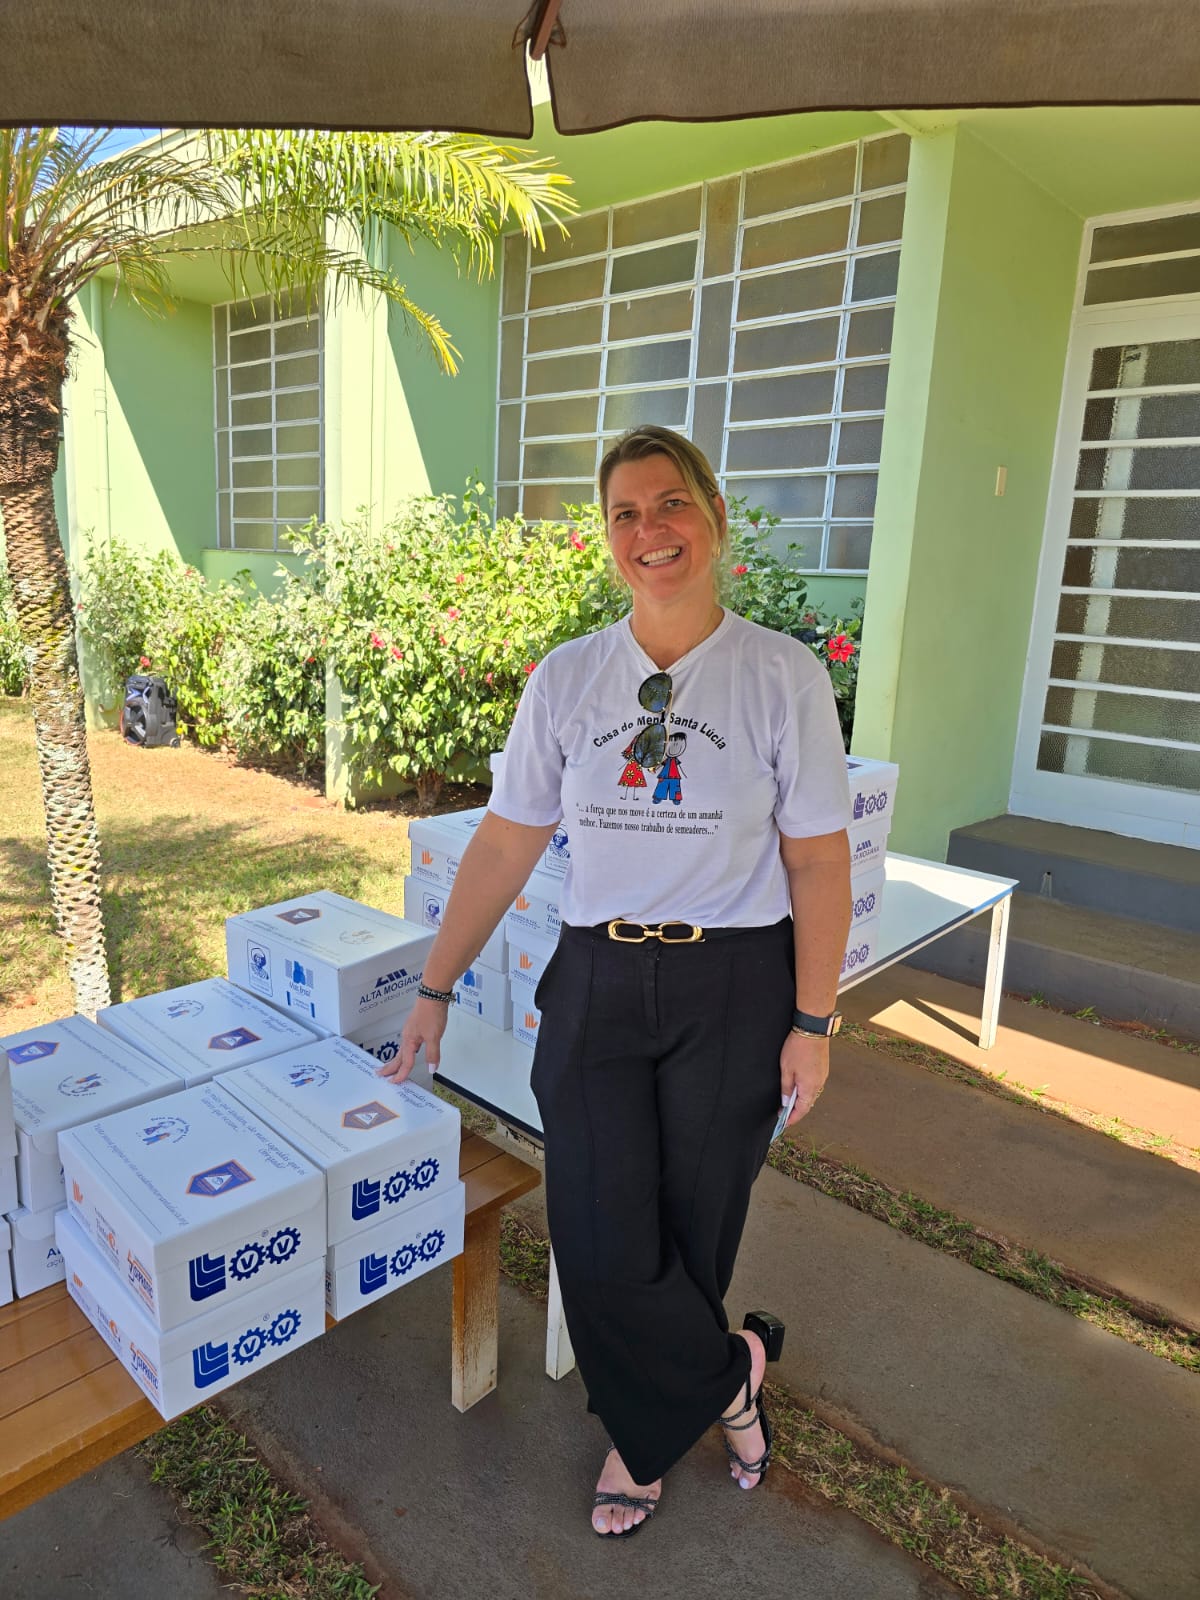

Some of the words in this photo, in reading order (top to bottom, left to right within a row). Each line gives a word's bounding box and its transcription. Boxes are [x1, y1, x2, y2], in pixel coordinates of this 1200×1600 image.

[593, 728, 619, 748] Casa
[621, 722, 634, 732] do
[670, 712, 699, 730] Santa
[700, 723, 727, 750] Lúcia
[590, 803, 605, 817] força
[606, 807, 617, 817] que
[618, 808, 628, 816] nos
[629, 809, 645, 817] move
[656, 810, 677, 819] certeza
[678, 809, 686, 819] de
[687, 812, 697, 820] um
[698, 809, 724, 820] amanhã
[599, 818, 623, 830] Fazemos
[624, 823, 640, 832] nosso
[641, 823, 665, 833] trabalho
[666, 823, 674, 834] de
[360, 989, 382, 1006] ALTA
